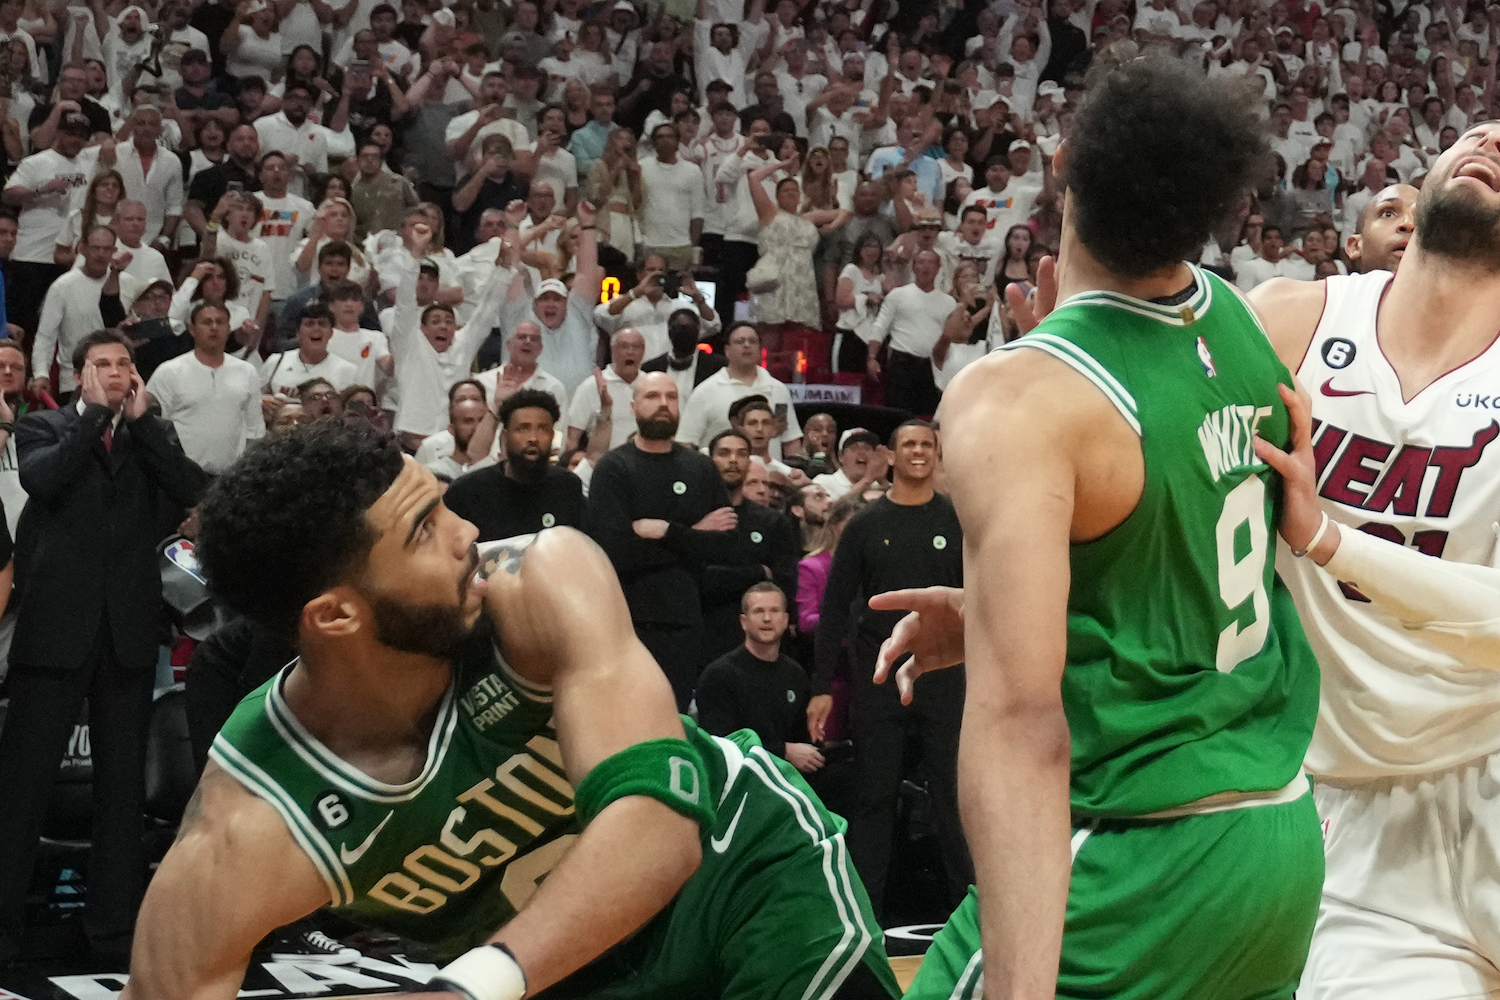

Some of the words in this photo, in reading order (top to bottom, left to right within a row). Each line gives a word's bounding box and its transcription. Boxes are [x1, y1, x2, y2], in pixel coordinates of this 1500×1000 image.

[1326, 340, 1351, 368] 6
[1197, 404, 1274, 483] WHITE
[1216, 473, 1270, 674] 9
[473, 691, 521, 732] PRINT
[317, 793, 349, 828] 6
